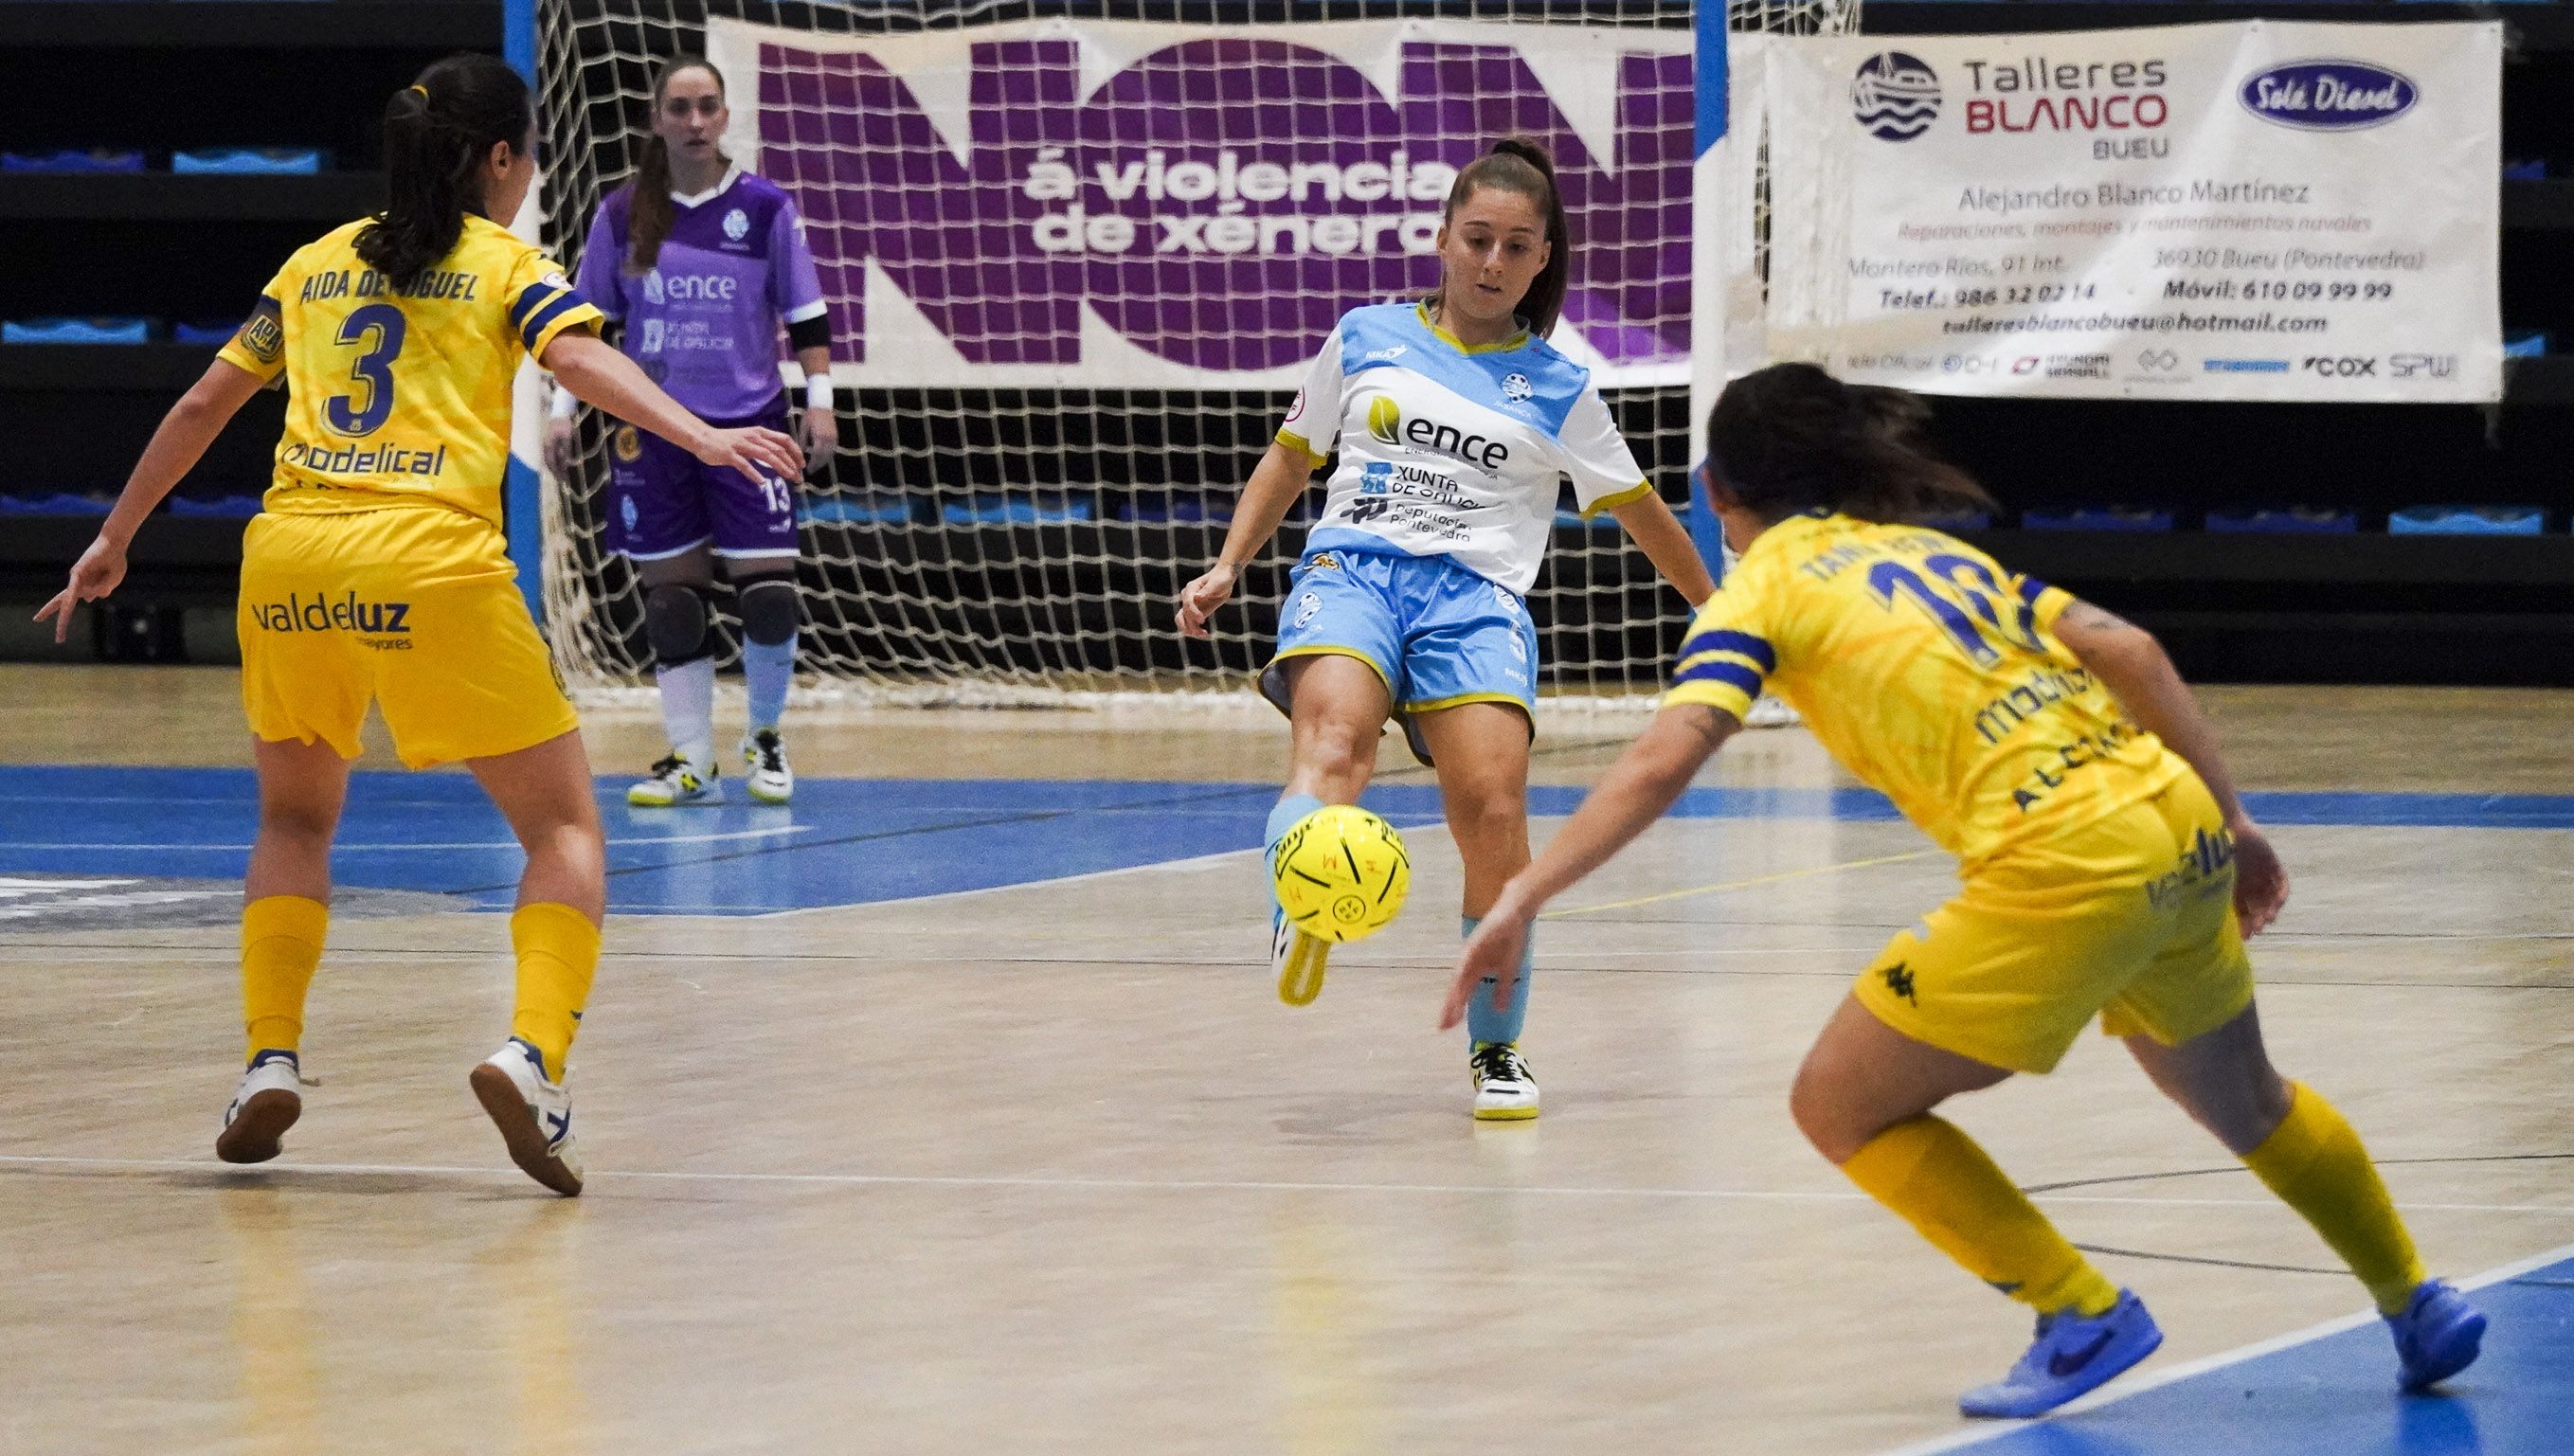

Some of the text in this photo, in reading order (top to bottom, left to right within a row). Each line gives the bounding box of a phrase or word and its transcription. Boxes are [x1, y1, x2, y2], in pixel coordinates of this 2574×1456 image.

[1963, 57, 2167, 92] Talleres
[1965, 94, 2168, 134] BLANCO
[2093, 137, 2169, 160] BUEU
[1023, 148, 1459, 202] á violencia
[758, 38, 1694, 370] NON
[1958, 177, 2312, 216] Alejandro Blanco Martínez
[1032, 201, 1445, 256] de xénero
[2223, 247, 2276, 269] Bueu
[2283, 245, 2426, 272] (Pontevedra)
[299, 269, 351, 305] AIDA
[390, 270, 478, 301] IGUEL
[667, 274, 737, 300] ence
[2163, 279, 2393, 300] Móvil: 610 09 99 99
[1943, 312, 2328, 335] talleresblancobueu@hotmail.com
[320, 303, 407, 439] 3
[2316, 356, 2376, 377] COX
[1406, 417, 1509, 470] ence
[759, 478, 792, 512] 13
[1392, 481, 1416, 496] DE
[1395, 465, 1458, 494] XUNTA
[251, 590, 411, 634] valdeluz
[1866, 551, 2048, 670] 10
